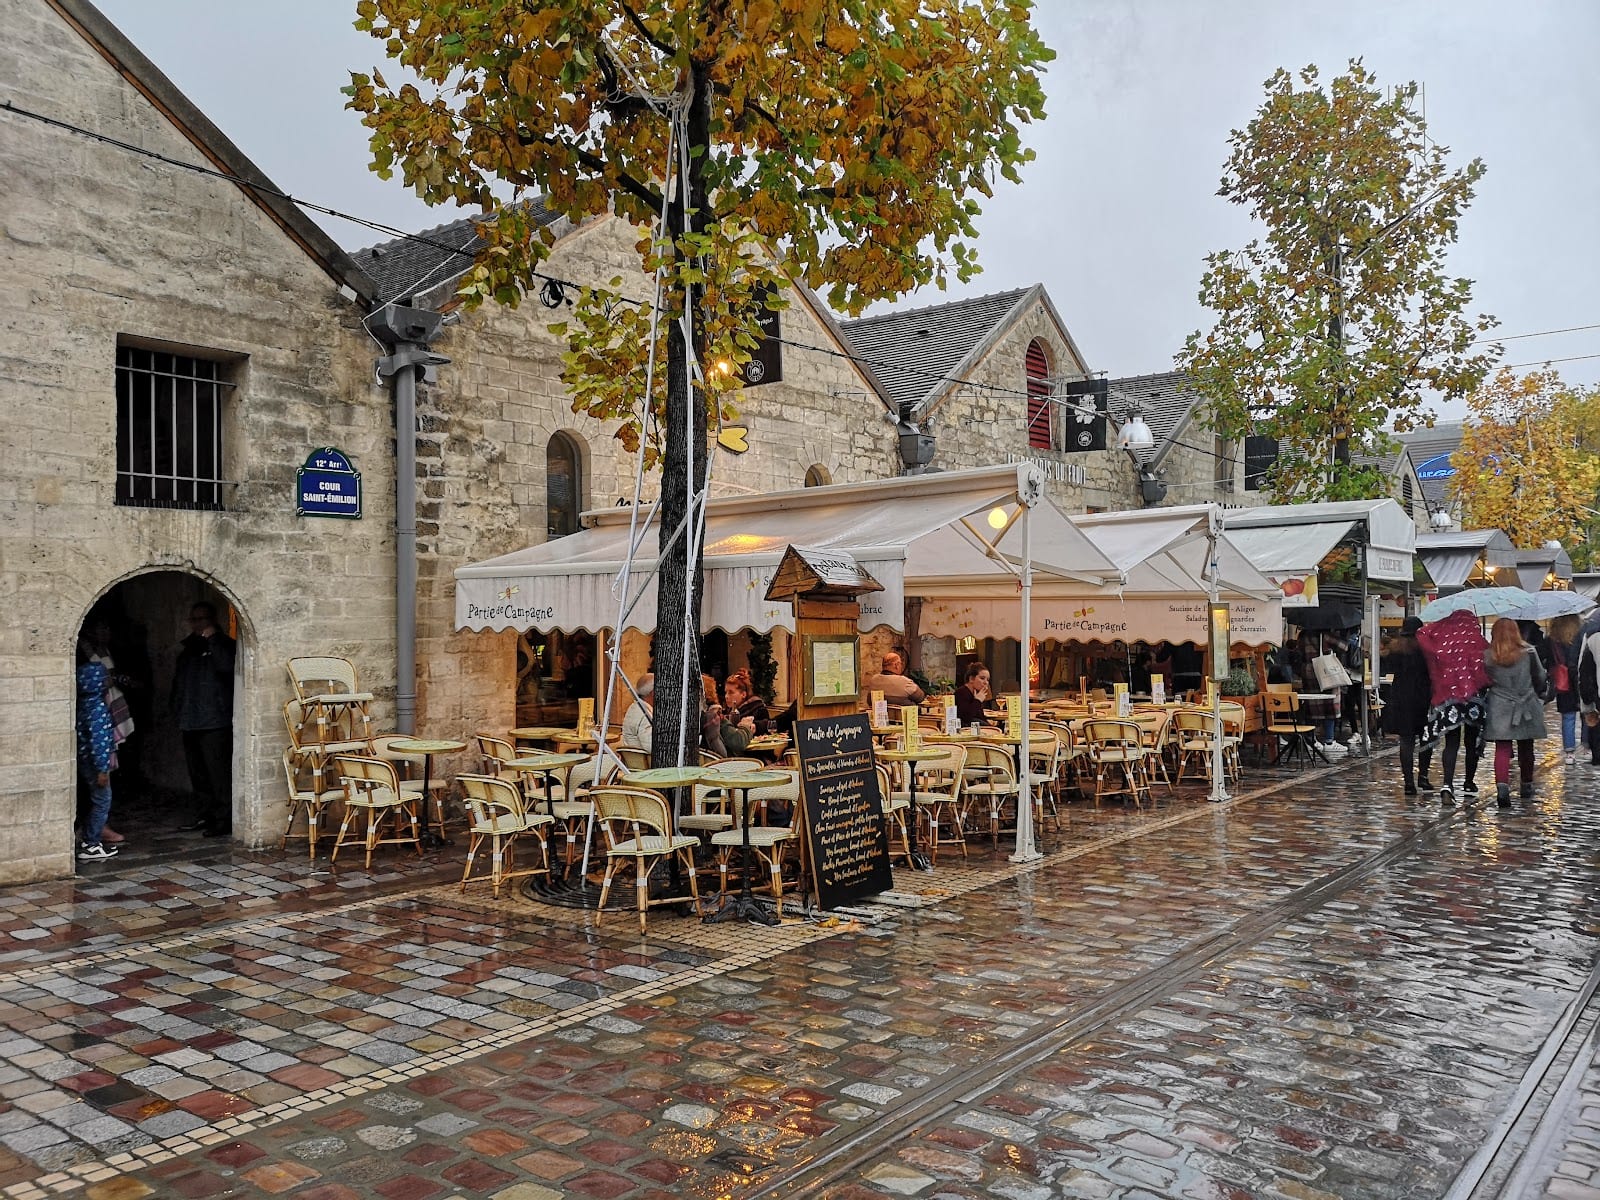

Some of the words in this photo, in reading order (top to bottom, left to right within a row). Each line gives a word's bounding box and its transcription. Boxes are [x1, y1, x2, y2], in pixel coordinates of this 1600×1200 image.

[319, 481, 341, 492] COUR
[303, 492, 357, 505] SAINT-ÉMILION
[467, 603, 496, 620] Partie
[496, 605, 504, 615] de
[504, 603, 553, 622] Campagne
[859, 603, 883, 615] ubrac
[1168, 604, 1193, 612] Saucisse
[1194, 604, 1201, 612] de
[1235, 605, 1256, 614] Aligot
[1044, 618, 1072, 632] Partie
[1073, 620, 1080, 628] de
[1080, 620, 1127, 634] Campagne
[1231, 615, 1255, 625] gnardes
[1231, 624, 1238, 632] de
[1239, 624, 1267, 632] Sarrazin
[807, 726, 825, 741] Partie
[834, 723, 863, 740] Campagne
